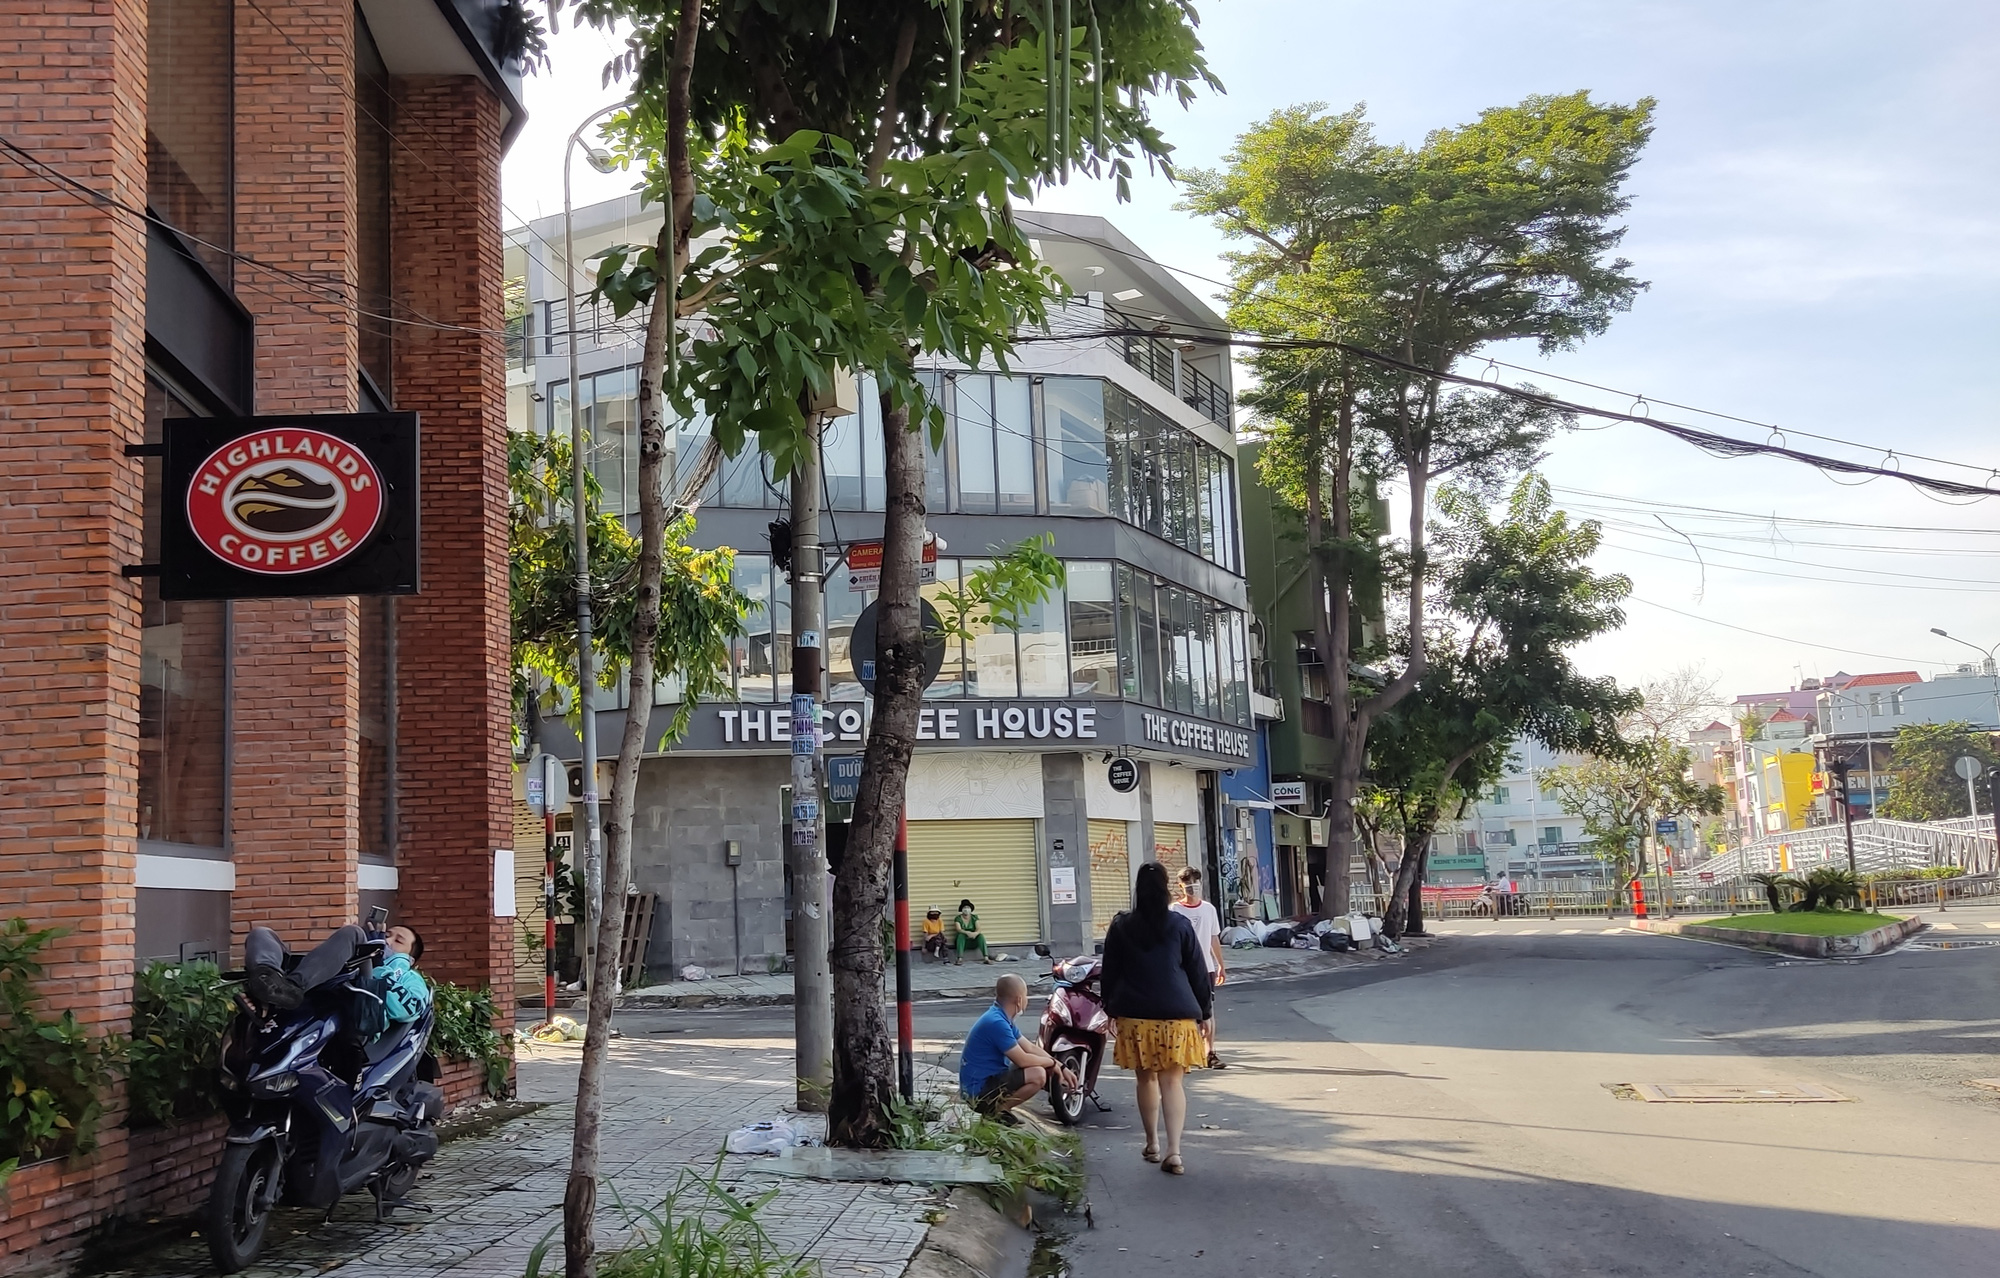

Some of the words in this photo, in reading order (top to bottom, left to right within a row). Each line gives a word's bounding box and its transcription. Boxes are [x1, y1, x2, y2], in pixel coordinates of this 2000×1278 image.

[198, 436, 371, 497] HIGHLANDS
[218, 528, 352, 566] COFFEE
[852, 547, 883, 557] CAMERA
[718, 709, 792, 742] THE
[822, 707, 960, 743] COEE
[976, 707, 1098, 740] HOUSE
[1144, 713, 1168, 743] THE
[1171, 719, 1214, 751] COFFEE
[1217, 728, 1249, 758] HOUSE
[838, 759, 864, 777] ĐƯỜ
[833, 784, 853, 798] HOA
[557, 837, 569, 846] 41
